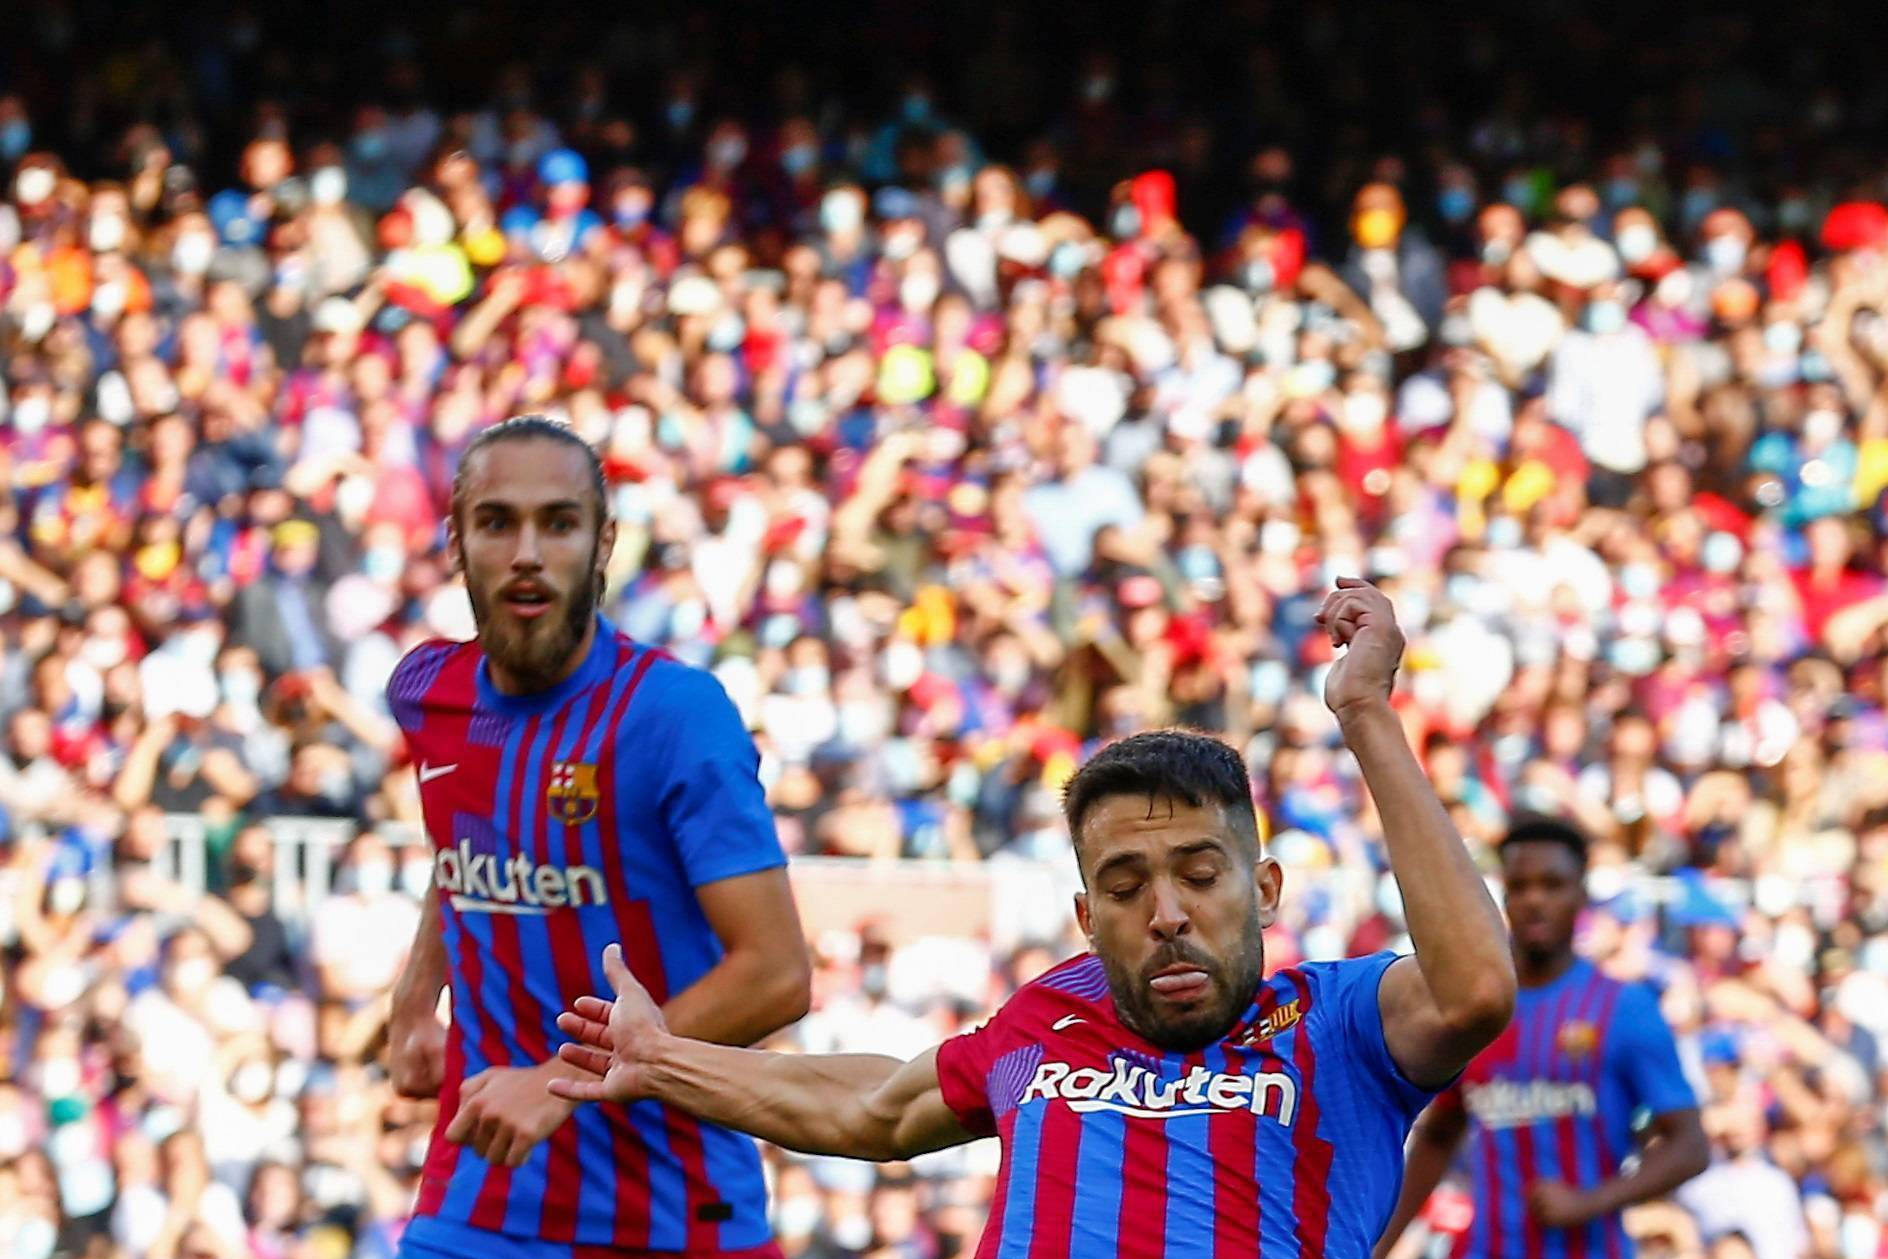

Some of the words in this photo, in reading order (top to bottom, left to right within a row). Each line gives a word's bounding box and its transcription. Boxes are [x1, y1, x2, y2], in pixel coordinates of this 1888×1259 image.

[436, 838, 607, 907] akuten
[1019, 1057, 1298, 1127] Rakuten
[1461, 1075, 1597, 1121] akuten
